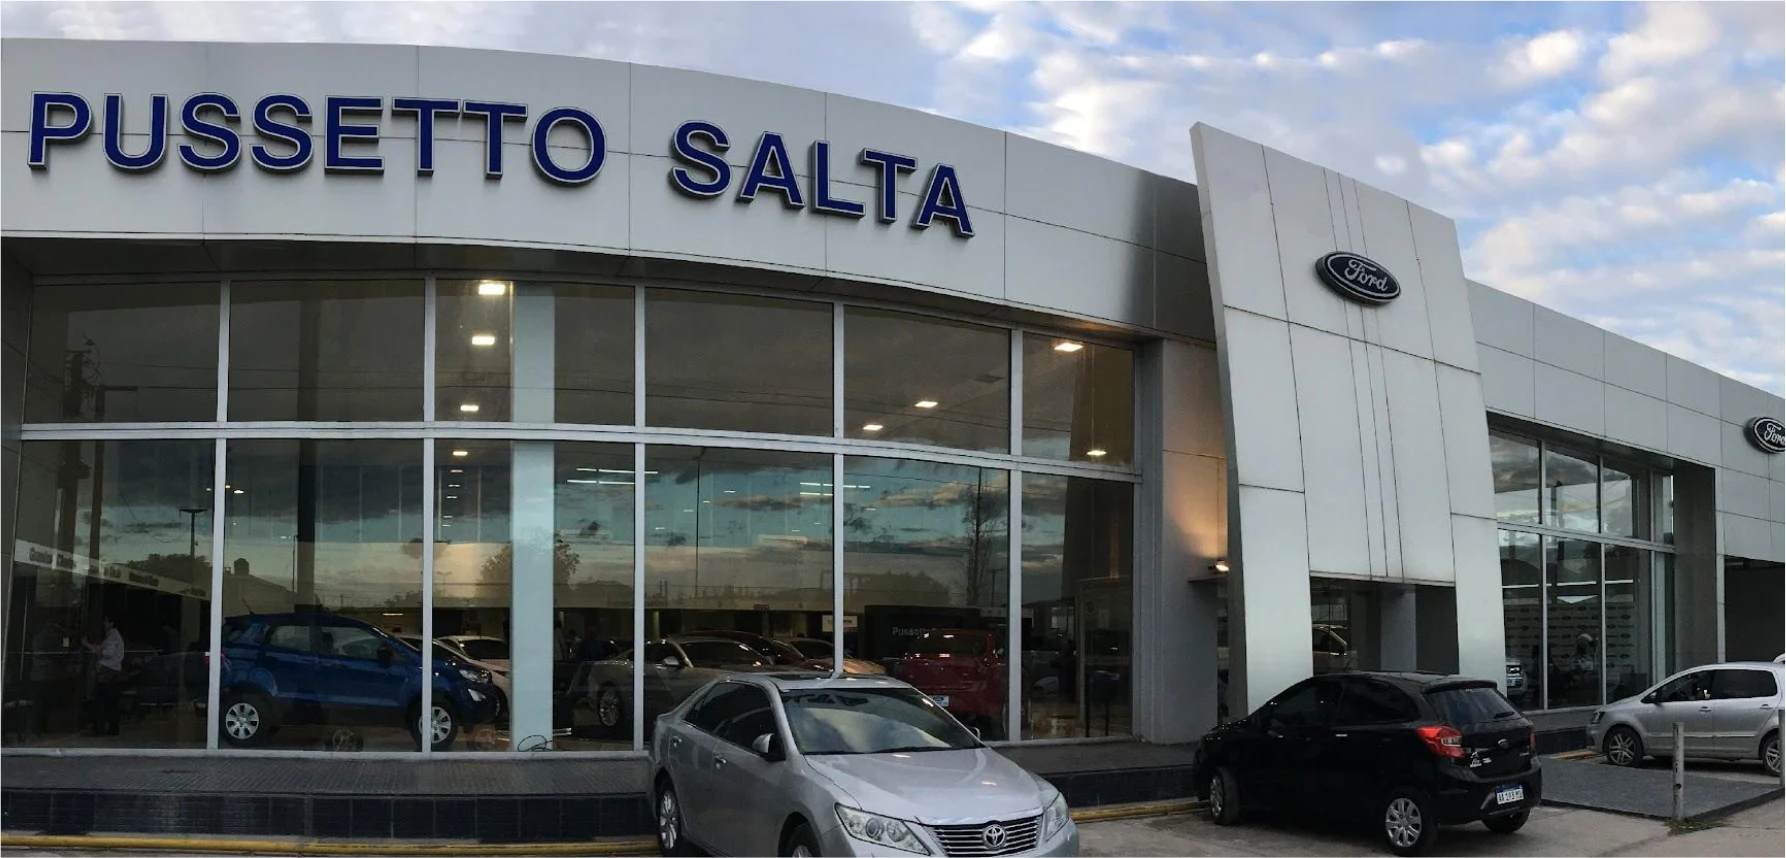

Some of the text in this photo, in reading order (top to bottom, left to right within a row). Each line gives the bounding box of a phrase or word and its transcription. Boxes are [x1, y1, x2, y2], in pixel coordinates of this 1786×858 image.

[28, 92, 975, 238] PUSSETTO SALTA
[1344, 259, 1388, 292] Ford
